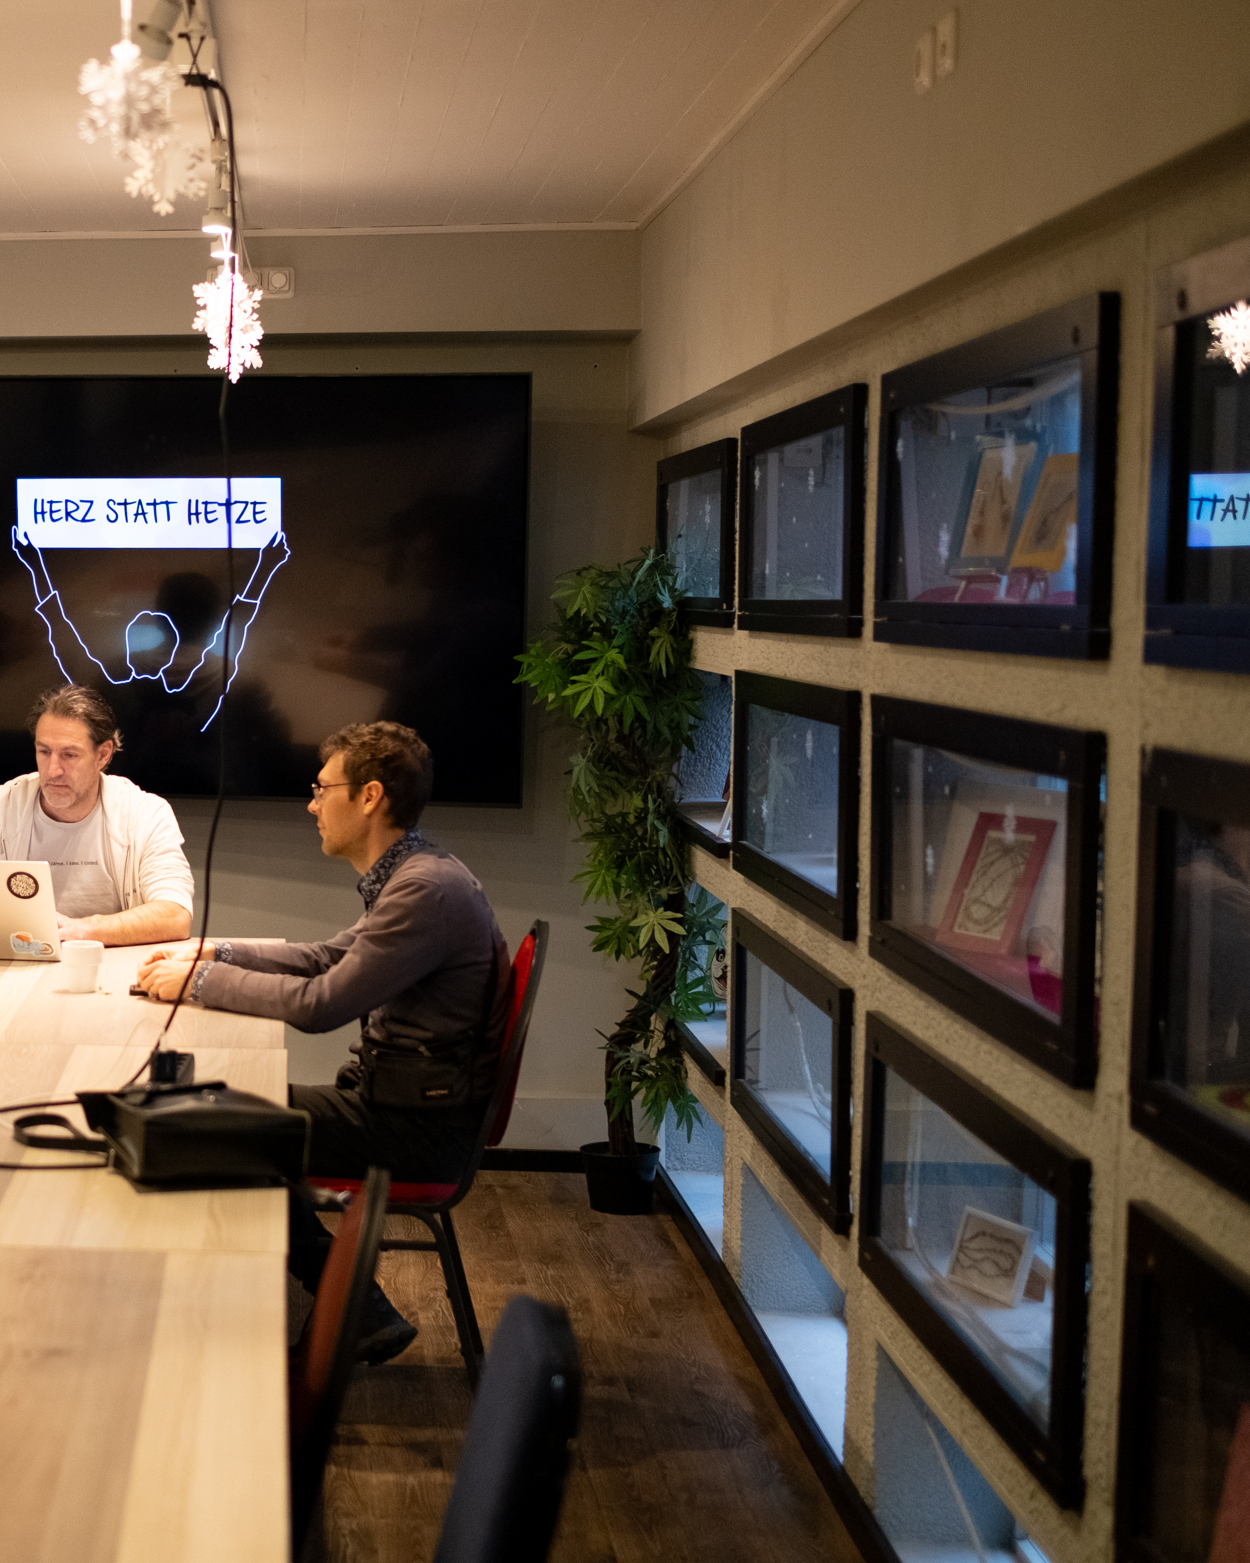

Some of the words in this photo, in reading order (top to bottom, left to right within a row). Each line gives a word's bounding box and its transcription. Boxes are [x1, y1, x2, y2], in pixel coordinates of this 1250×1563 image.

[33, 498, 96, 524] HERZ
[106, 498, 178, 524] STATT
[187, 498, 268, 525] HETZE
